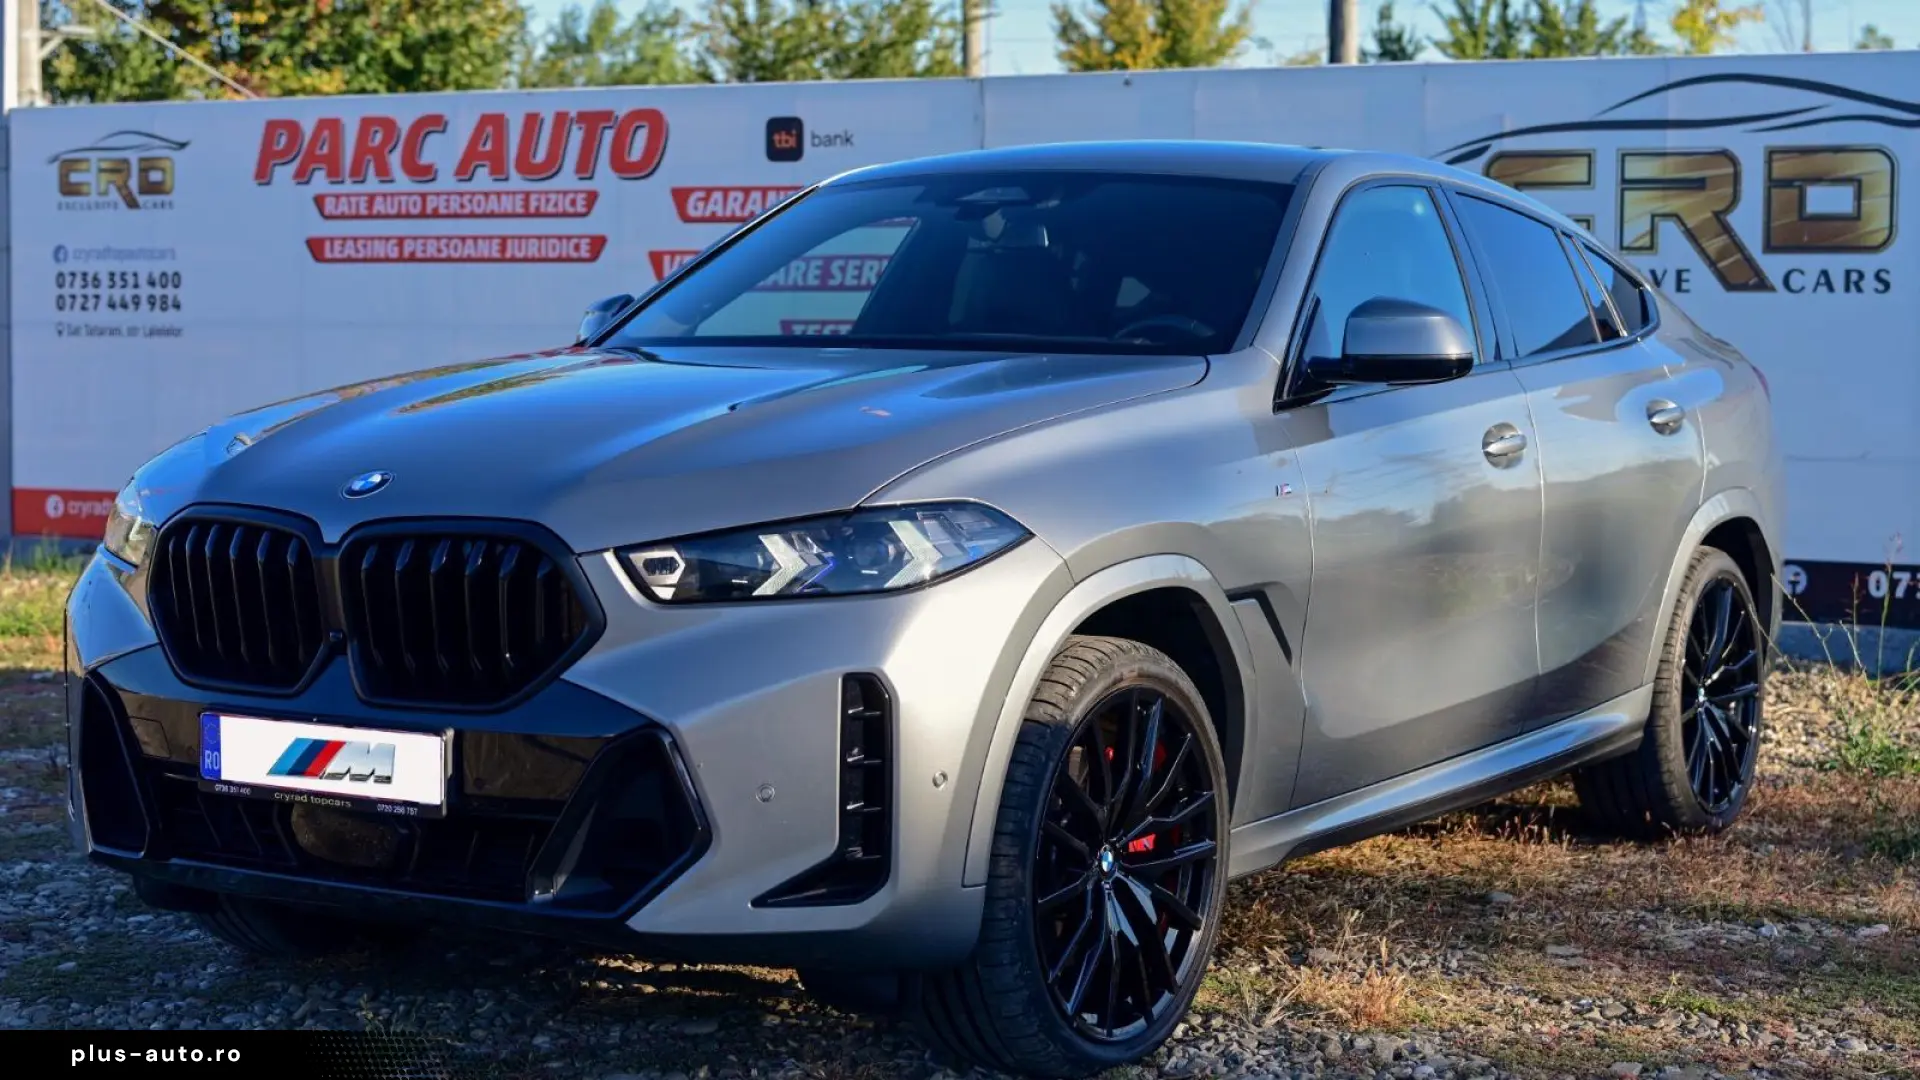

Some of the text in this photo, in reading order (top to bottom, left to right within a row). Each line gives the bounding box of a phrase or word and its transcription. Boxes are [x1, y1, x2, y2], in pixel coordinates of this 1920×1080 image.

[253, 107, 669, 186] PARC AUTO
[772, 130, 854, 148] tbi bank
[59, 156, 175, 209] CRD
[324, 192, 588, 216] RATE AUTO PERSOANE FIZICE
[686, 189, 796, 217] GARAN
[324, 238, 591, 259] LEASING PERSOANE JURIDICE
[55, 271, 182, 289] 0736 351 400
[1782, 268, 1892, 294] CARS
[55, 294, 182, 312] 0727 449 984
[1868, 570, 1920, 599] 07
[204, 750, 220, 770] RO
[274, 792, 352, 808] cryrad topcars
